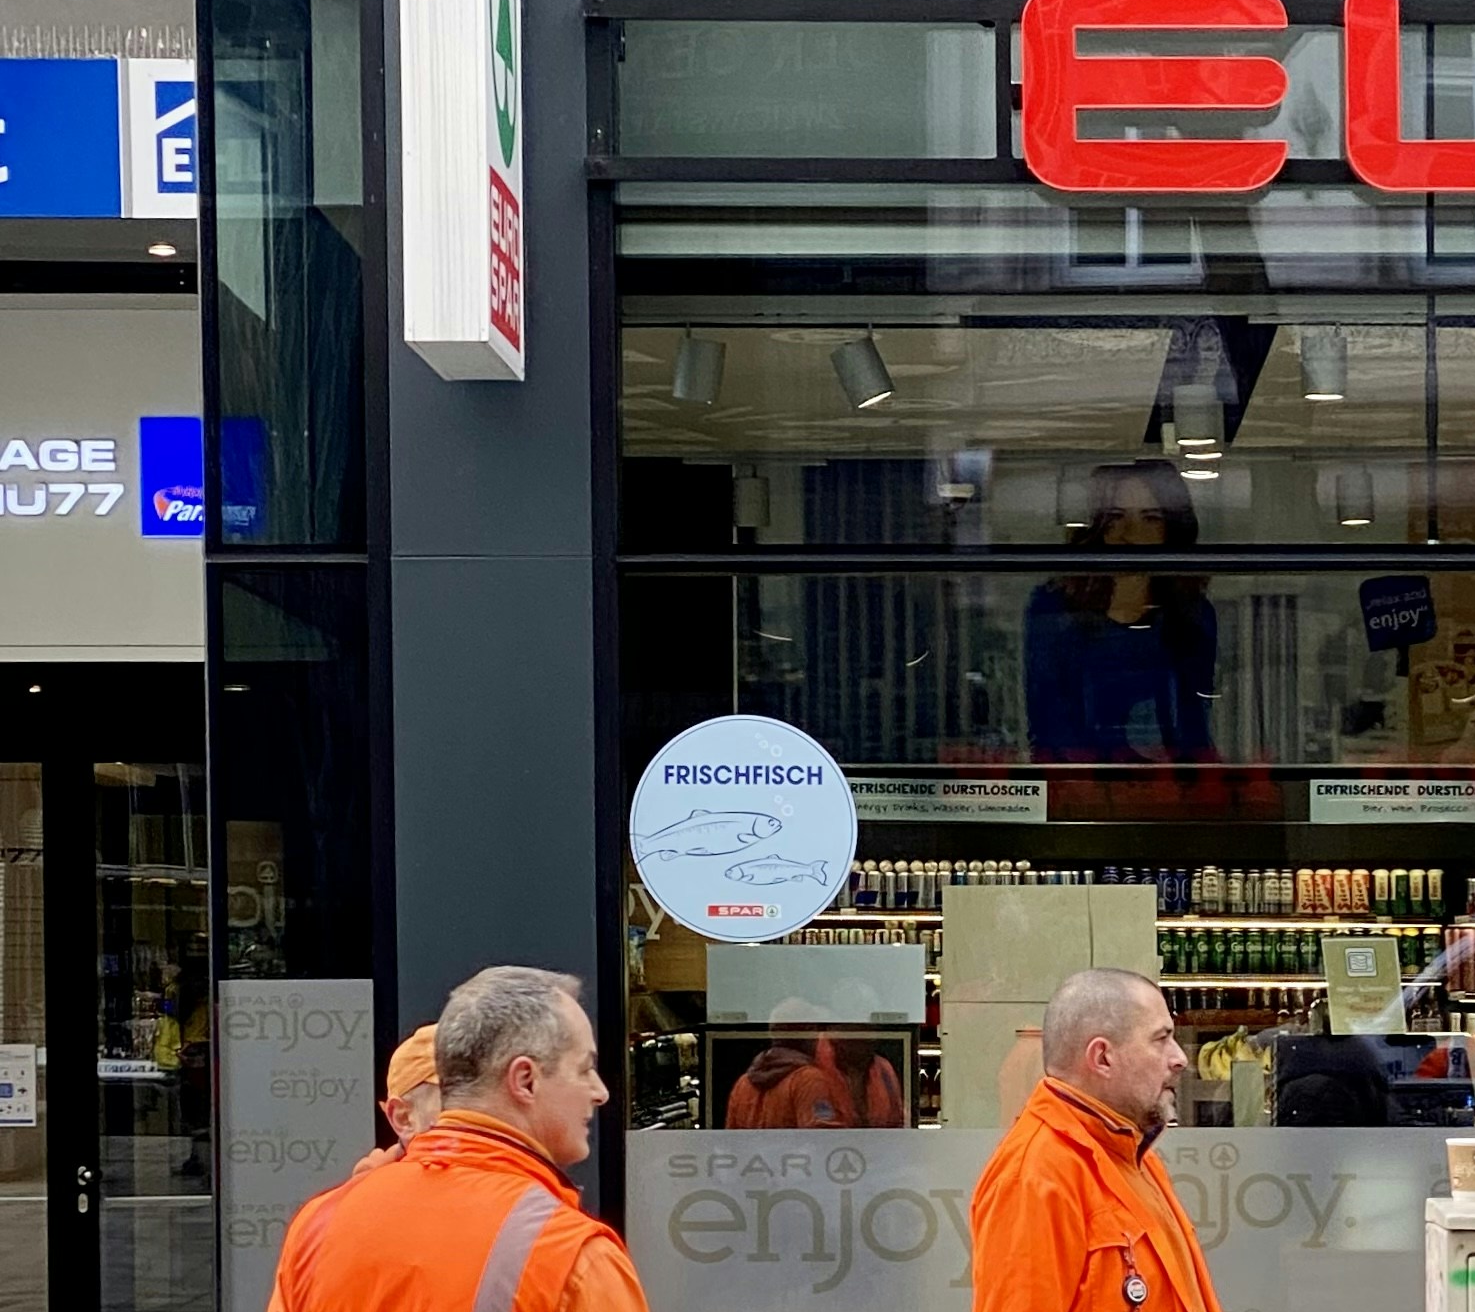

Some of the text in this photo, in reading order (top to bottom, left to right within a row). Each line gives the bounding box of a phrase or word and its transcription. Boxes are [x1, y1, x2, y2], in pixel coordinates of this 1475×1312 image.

[491, 252, 521, 337] SPAR
[0, 439, 117, 472] AGE
[0, 483, 125, 516] U77
[664, 764, 823, 786] FRISCHFISCH
[1316, 784, 1410, 796] ERFRISCHENDE
[717, 906, 763, 916] SPAR
[224, 1009, 370, 1053] enjoy.
[269, 1077, 360, 1107] enjoy.
[226, 1137, 339, 1174] enjoy.
[667, 1153, 813, 1179] SPAR
